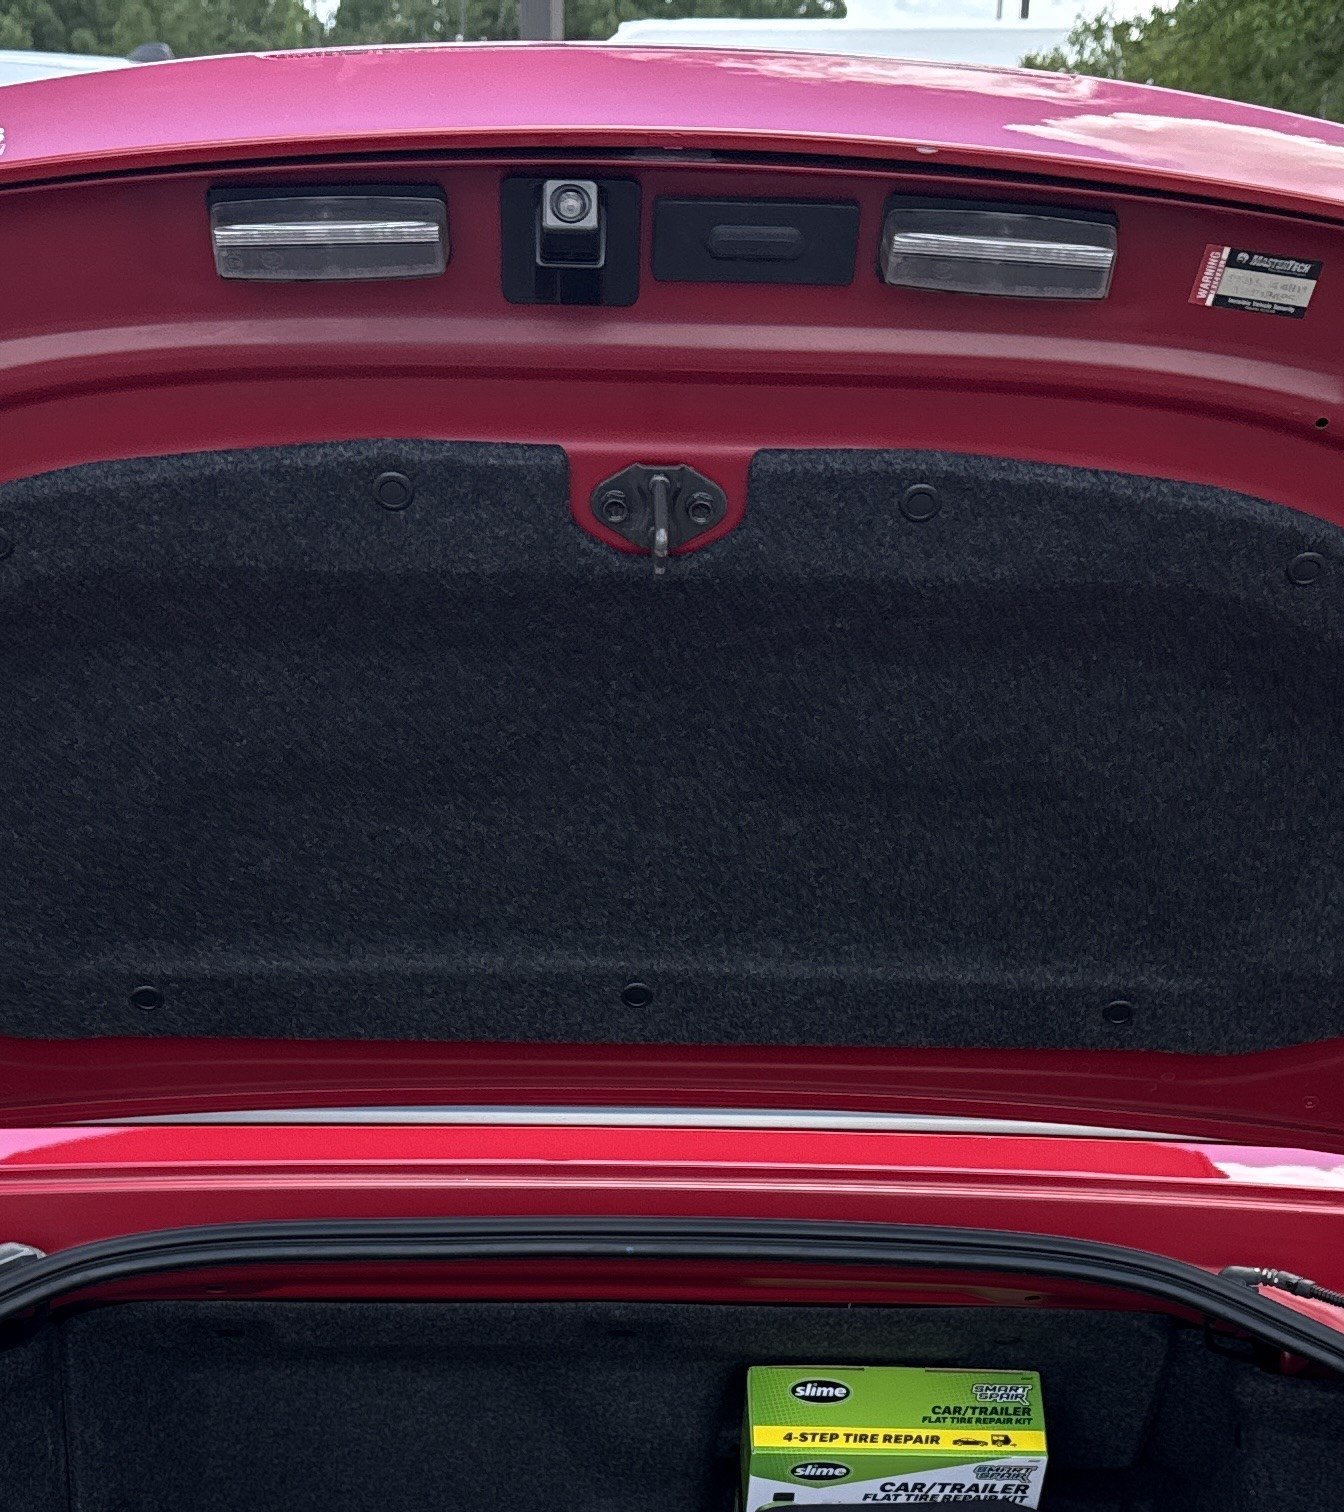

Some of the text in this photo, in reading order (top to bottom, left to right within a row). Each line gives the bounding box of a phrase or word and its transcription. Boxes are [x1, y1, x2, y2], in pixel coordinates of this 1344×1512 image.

[1197, 251, 1222, 299] WARNING
[794, 1383, 847, 1398] slime
[973, 1384, 1032, 1393] SMART
[931, 1405, 1032, 1417] CAR/TRAILER
[921, 1415, 1033, 1426] FLAT TIRE REPAIR KIT
[783, 1432, 941, 1445] 4-STEP TIRE REPAIR
[793, 1464, 847, 1477] slime
[879, 1481, 1030, 1495] CAR/TRAILER
[862, 1493, 905, 1502] FLAT
[906, 1493, 940, 1502] TIRE
